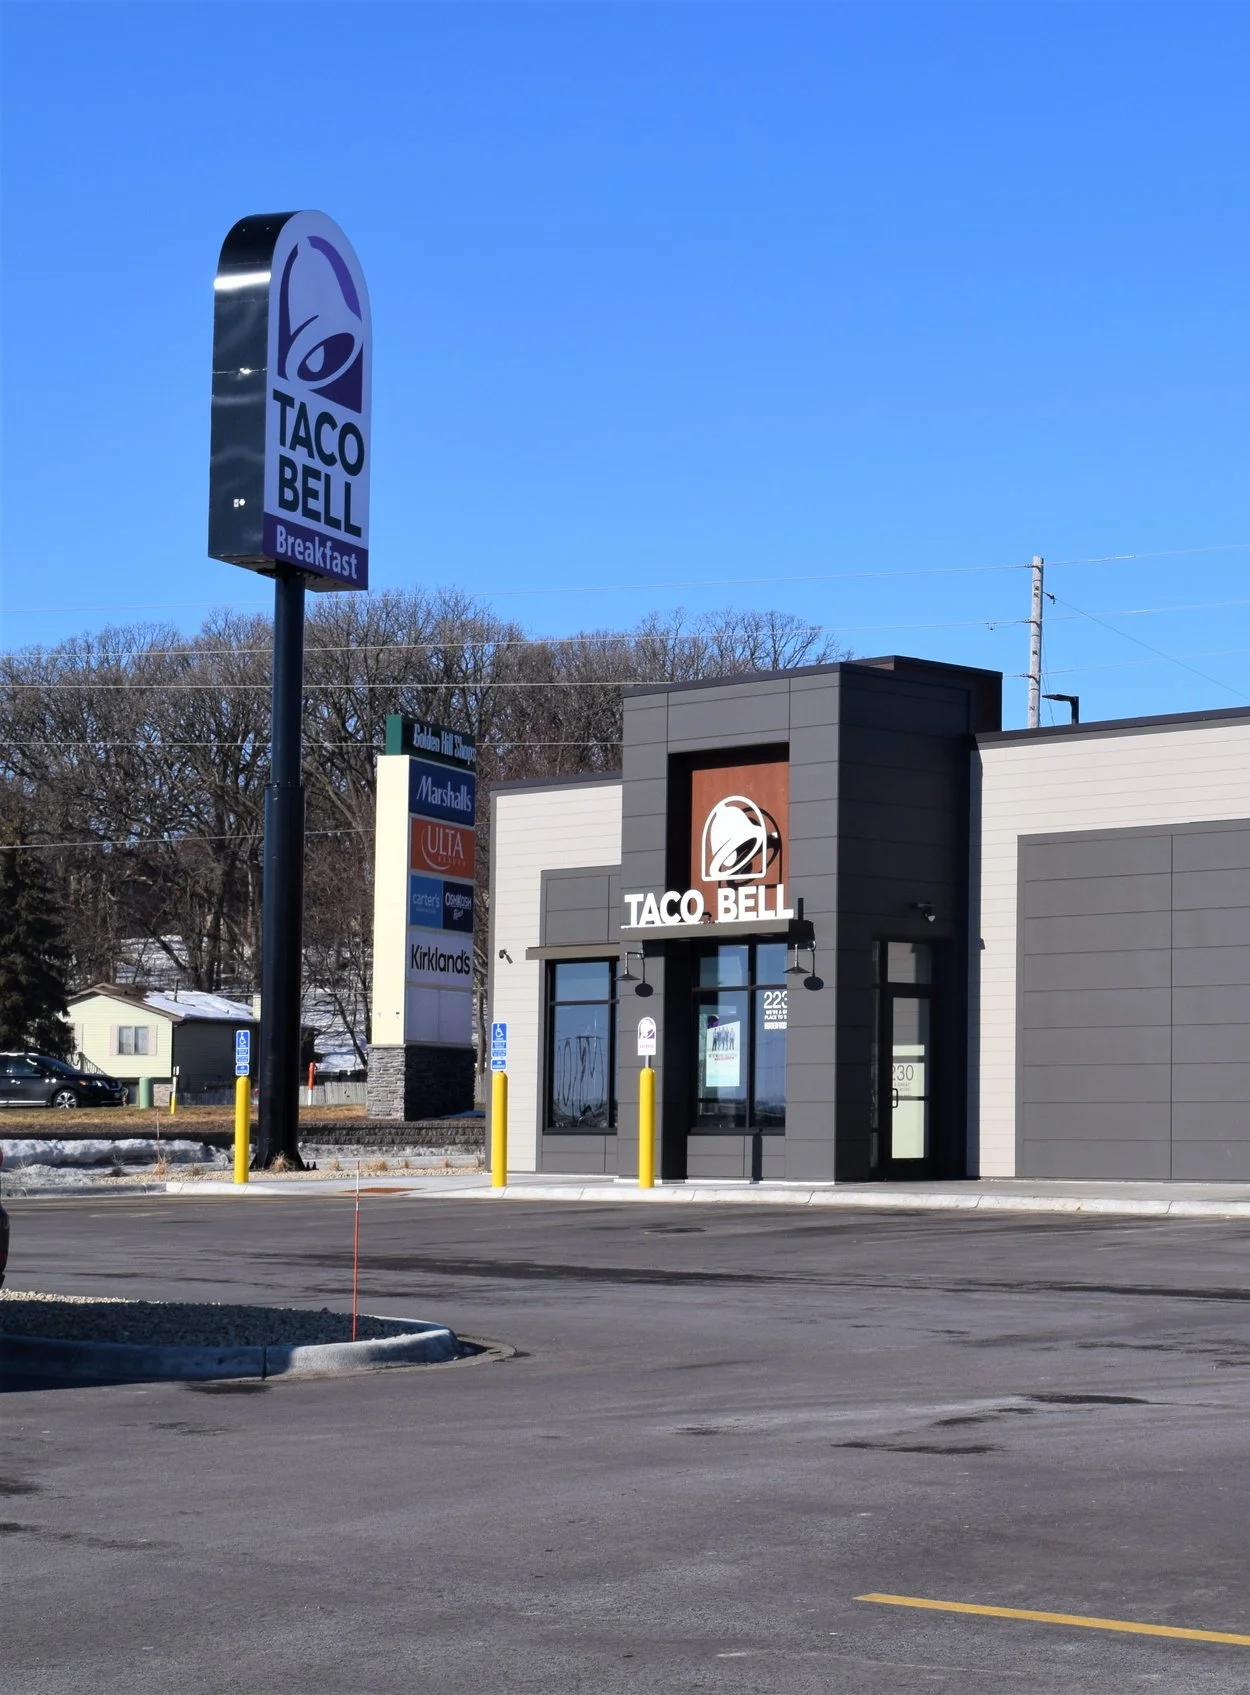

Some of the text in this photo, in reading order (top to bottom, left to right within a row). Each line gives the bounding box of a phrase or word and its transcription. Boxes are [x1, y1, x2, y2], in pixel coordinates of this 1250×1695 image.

[272, 387, 365, 477] TACO
[277, 454, 362, 539] BELL
[275, 524, 358, 580] Breakfast
[413, 723, 477, 765] Golden Hill Shops
[416, 775, 472, 813] Marshalls
[427, 824, 465, 860] ULTA
[412, 892, 440, 908] carter's
[624, 883, 794, 927] TACO BELL
[411, 943, 471, 975] Kirkland's
